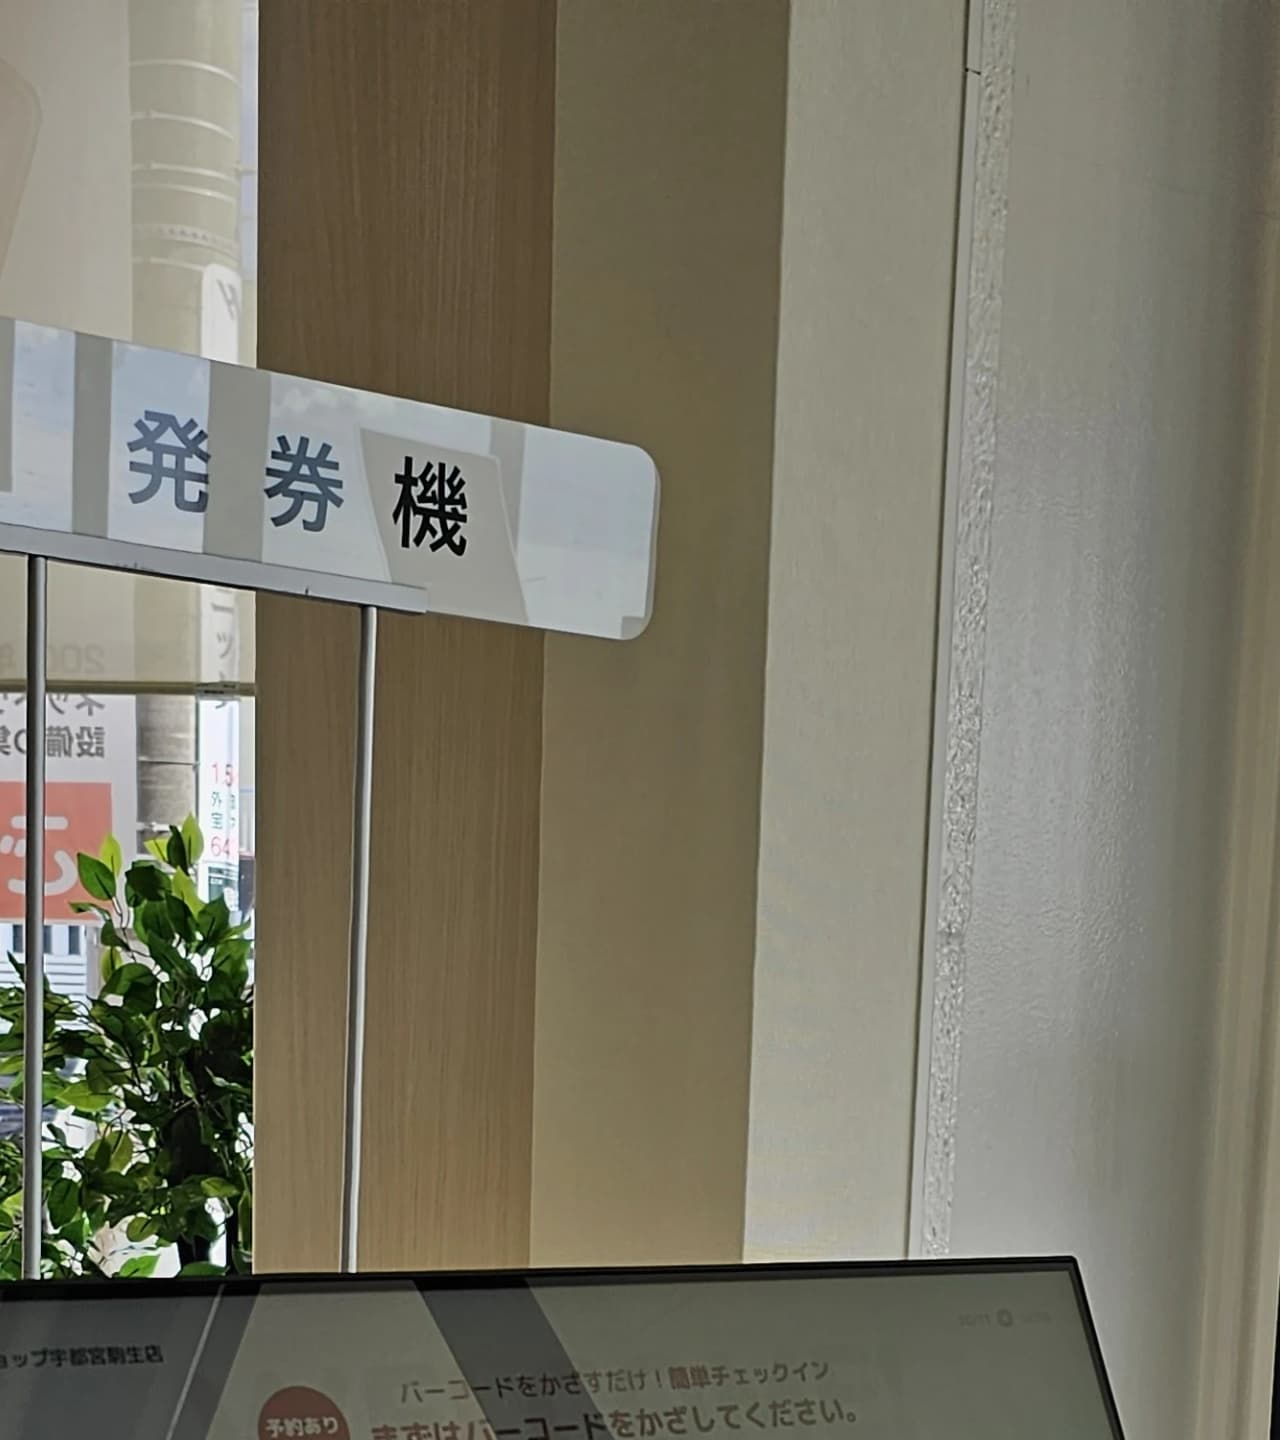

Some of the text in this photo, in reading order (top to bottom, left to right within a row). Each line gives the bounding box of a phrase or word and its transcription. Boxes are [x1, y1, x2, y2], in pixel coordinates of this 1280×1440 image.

[127, 410, 468, 557] 発券機
[264, 1415, 339, 1439] 予約あり
